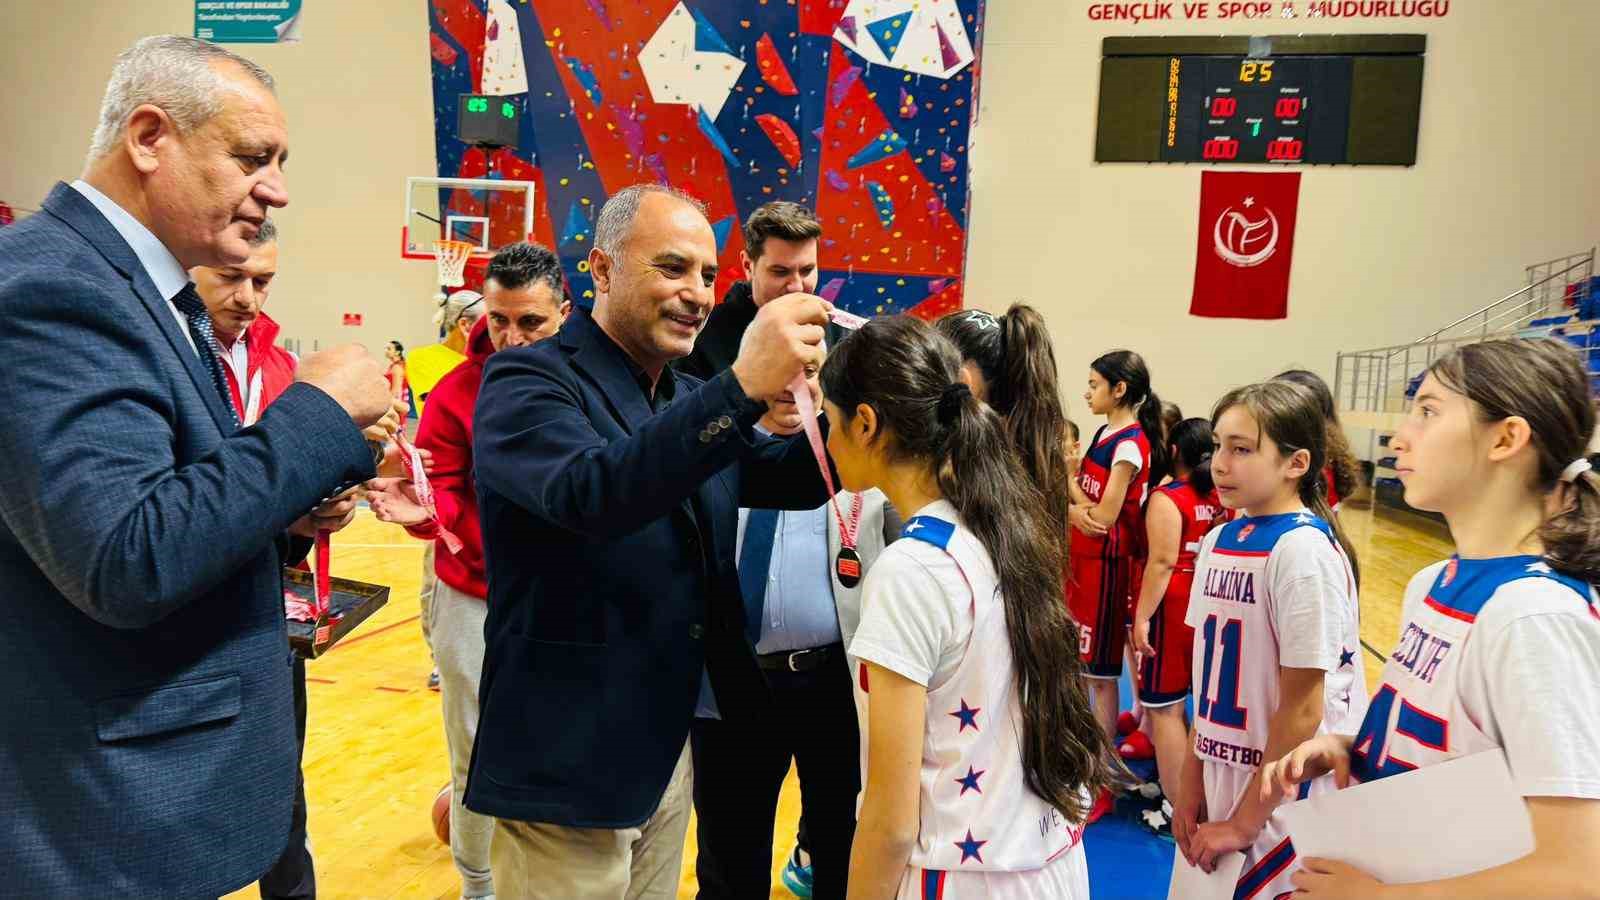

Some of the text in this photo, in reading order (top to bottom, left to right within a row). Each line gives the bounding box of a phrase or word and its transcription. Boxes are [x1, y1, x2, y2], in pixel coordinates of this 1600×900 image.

[1088, 0, 1171, 24] GENÇLİK
[1183, 2, 1208, 18] VE
[1217, 2, 1272, 18] SPOR
[1211, 97, 1236, 118] 00
[1274, 97, 1301, 118] 00
[1204, 567, 1256, 604] ALMİNA
[1198, 613, 1248, 730] 11
